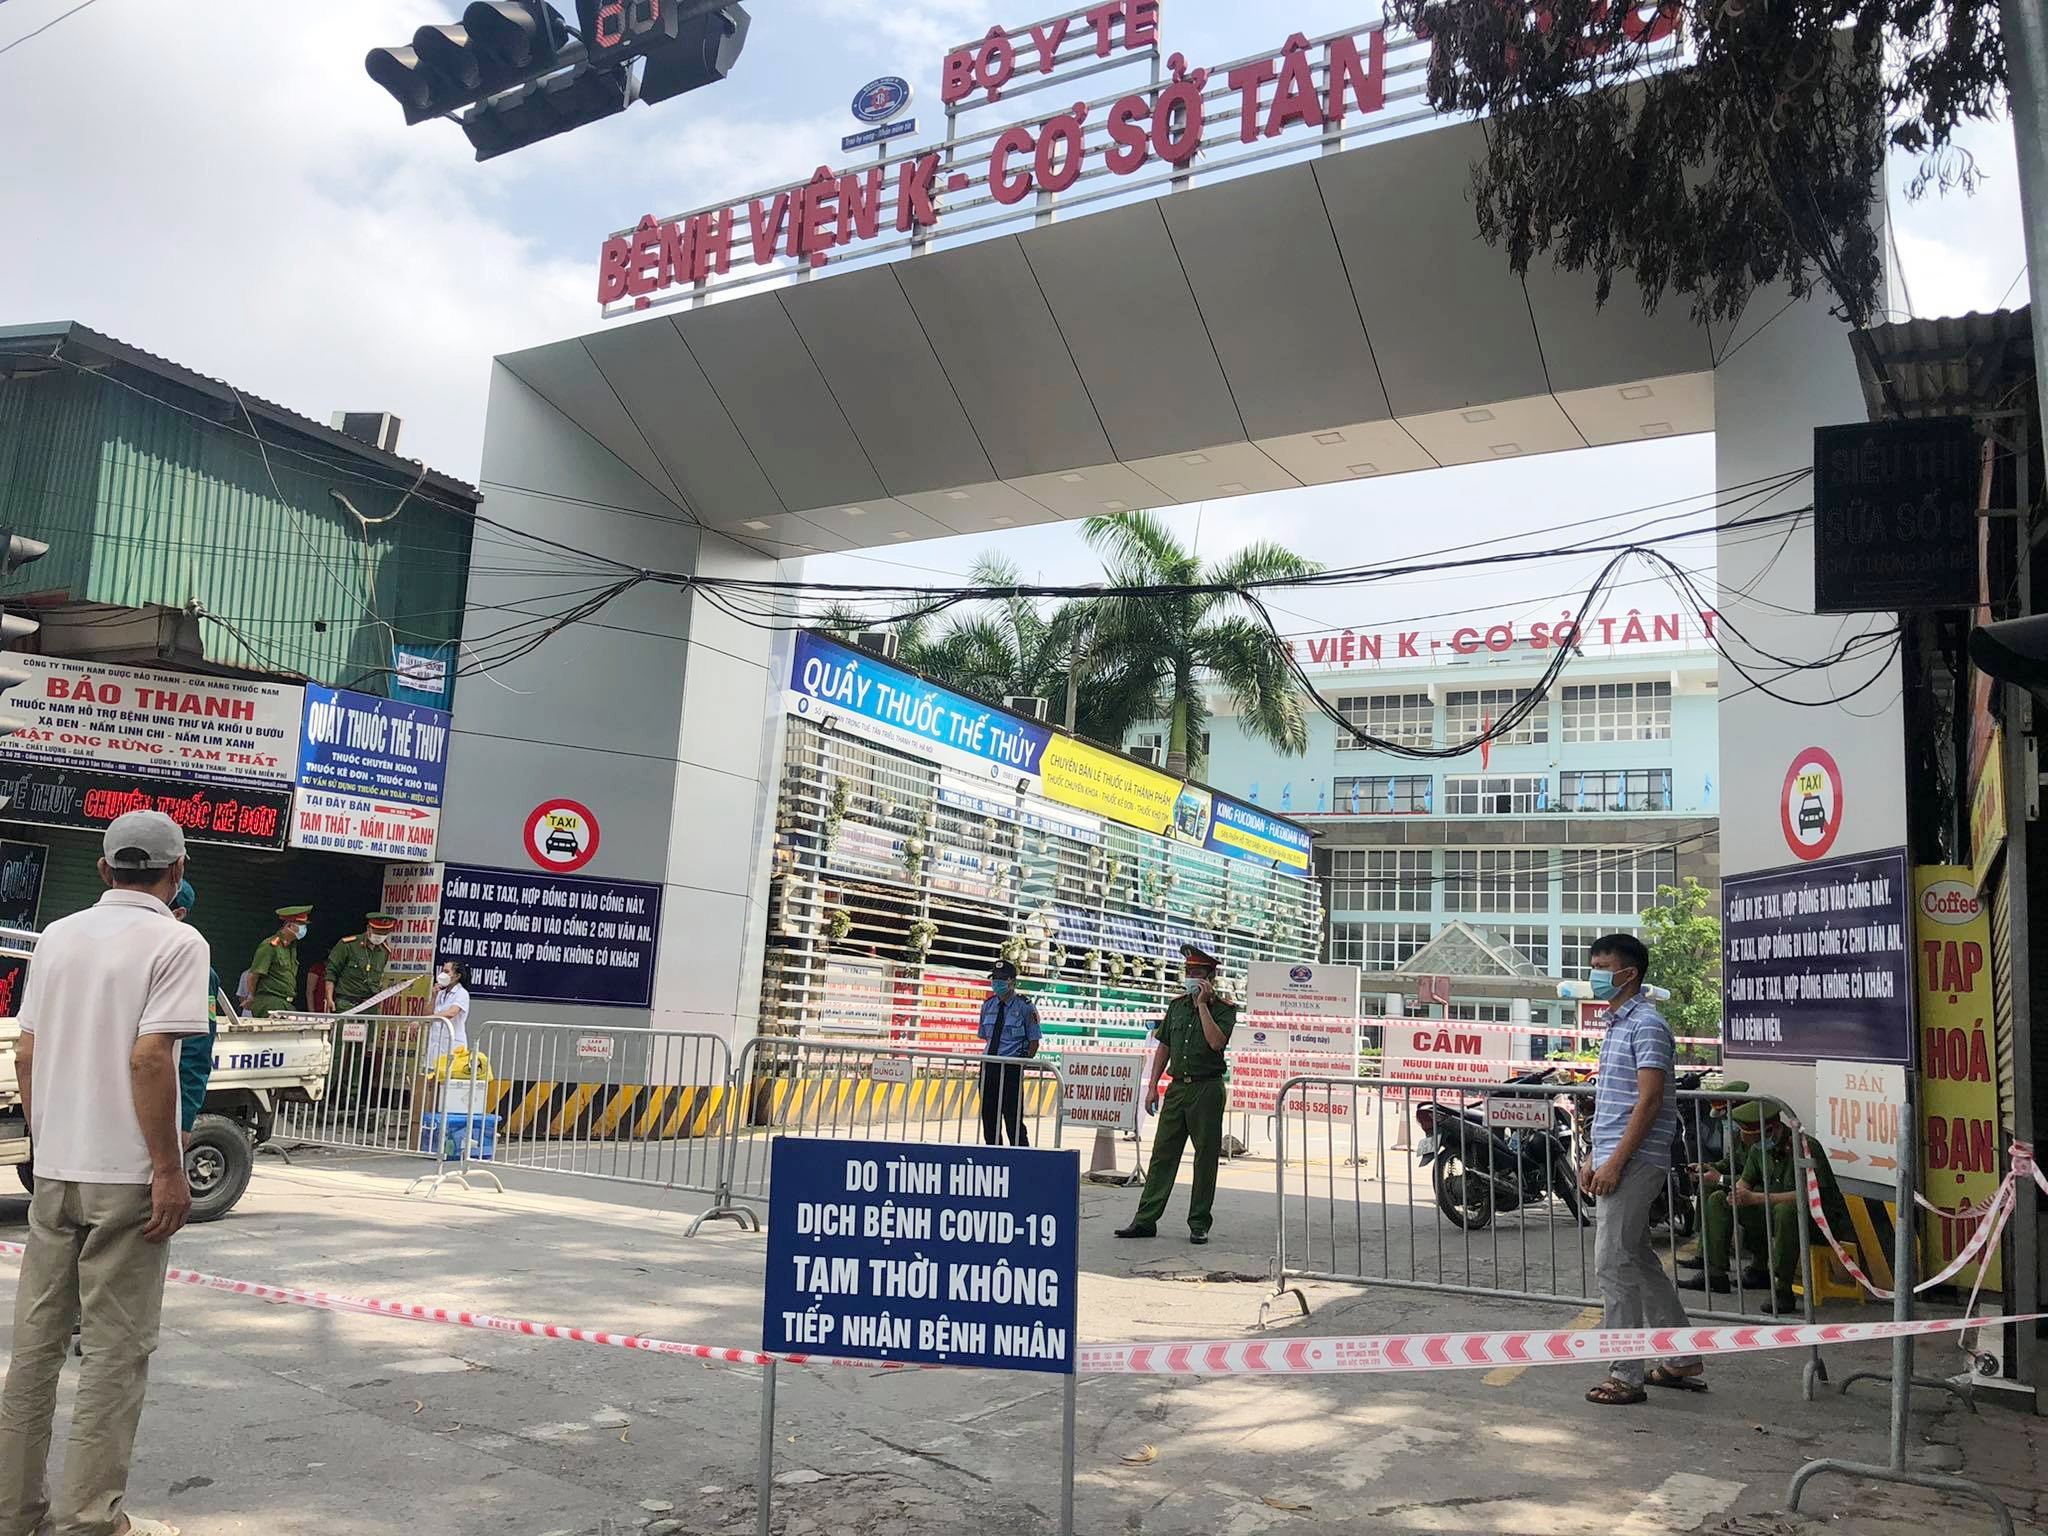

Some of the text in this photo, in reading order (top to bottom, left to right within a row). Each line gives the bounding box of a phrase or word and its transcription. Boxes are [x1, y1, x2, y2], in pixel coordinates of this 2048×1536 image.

[941, 24, 1016, 103] BỘ
[1030, 17, 1071, 74] Y
[597, 30, 1387, 311] BỆNH VIỆN K CƠ SỞ TÂN
[1307, 629, 1382, 668] VIỆN
[1399, 631, 1420, 657] K
[1452, 621, 1514, 654] CƠ
[1597, 609, 1680, 646] TÂN
[47, 674, 255, 721] BẢO THANH
[803, 656, 1037, 768] QUẦY THUỐC THẾ THỦY
[10, 697, 46, 711] THUỐC
[49, 702, 75, 714] NAM
[97, 707, 118, 720] TRỢ
[120, 709, 149, 724] BỆNH
[152, 714, 175, 726] UNG
[178, 717, 200, 729] THƯ
[201, 718, 215, 731] VÀ
[217, 721, 243, 734] KHỐI
[245, 726, 253, 735] U
[38, 716, 255, 749] XẠ ĐEN NẤM LINH CHI NẤM LIM XANH
[308, 692, 446, 763] QUẦY THUỐC THẾ THỦY
[60, 733, 102, 747] ONG
[107, 737, 164, 754] RỪNG
[179, 746, 221, 761] TAM
[226, 752, 278, 767] THẤT
[1800, 773, 1822, 793] TAXI
[306, 794, 371, 812] TẠI ĐÂY BÁN
[300, 810, 435, 846] TAM THẤT NẤM LIM XANH
[550, 815, 577, 828] TAXI
[384, 878, 440, 903] THUỐC NAM
[446, 875, 645, 914] CẤM ĐI XE TAXI, HỢP ĐỒNG ĐI VÀO CỔNG NÀY.
[1730, 872, 1891, 923] CẤM ĐI XE TAXI, HỢP ĐỒNG ĐI VÀO CỔNG NÀY.
[1924, 891, 1979, 914] Coffee
[442, 908, 652, 942] XE TAXI, HỢP ĐỒNG ĐI VÀO CỔNG 2 CHU VĂN AN.
[439, 931, 640, 968] CẤM ĐI XE TAXI, HỢP ĐỒNG KHÔNG CÓ KHÁCH
[484, 967, 508, 990] VIỆN.
[1922, 940, 1983, 1004] TẠP
[1731, 1013, 1782, 1046] VÀO BỆNH VIỆN.
[230, 1048, 285, 1070] TRIỀU
[1926, 1018, 1991, 1083] HOÁ
[1091, 1062, 1109, 1077] CÁC
[1110, 1066, 1131, 1081] LOẠI
[1845, 1069, 1884, 1093] BÁN
[1064, 1083, 1133, 1106] XE TAXI VÀO VIỆN
[1313, 1103, 1329, 1113] 528
[1332, 1104, 1348, 1115] 867
[1071, 1106, 1121, 1122] ĐÓN KHÁCH
[1492, 1108, 1545, 1124] DỪNG LẠI
[1828, 1096, 1862, 1144] TẠP
[1927, 1115, 1994, 1184] BẠN
[846, 1155, 1010, 1198] DO TÌNH HÌNH
[797, 1199, 1057, 1247] DỊCH BỆNH COVID-19
[793, 1252, 1059, 1307] TẠM THỜI KHÔNG
[782, 1304, 835, 1344] TIẾP
[842, 1310, 911, 1355] NHẬN
[919, 1314, 985, 1359] BỆNH
[994, 1320, 1066, 1360] NHÂN
